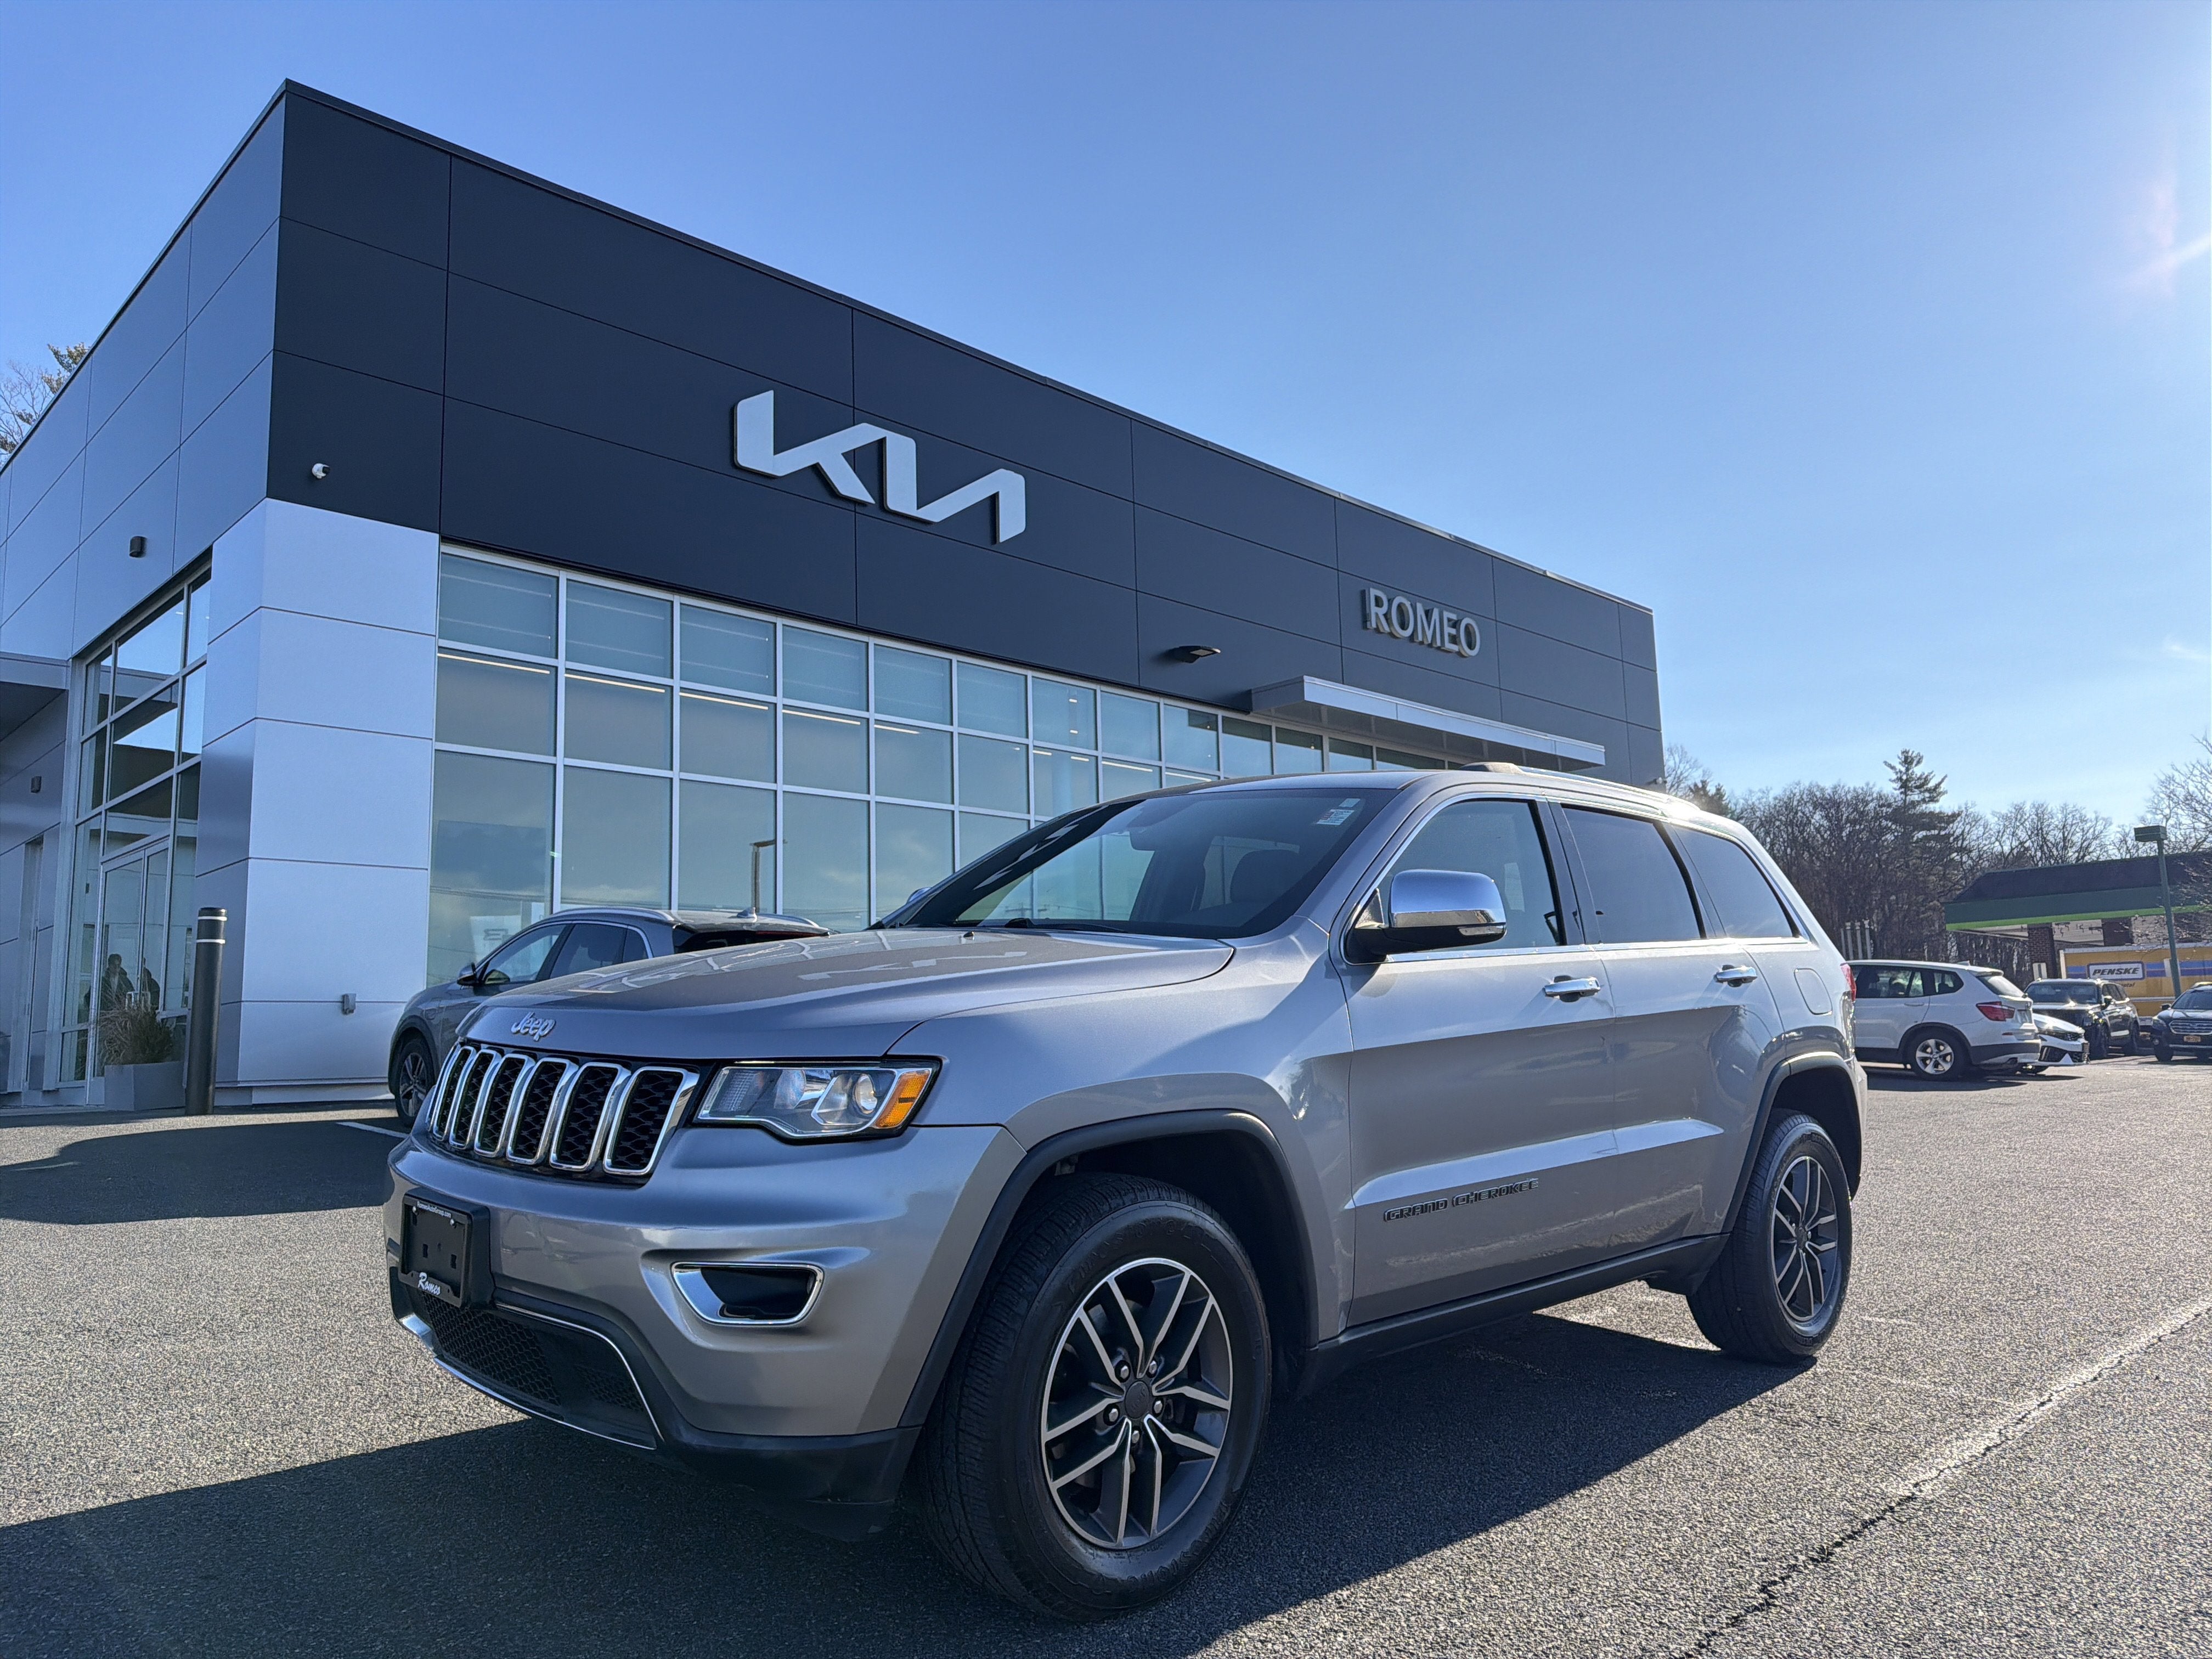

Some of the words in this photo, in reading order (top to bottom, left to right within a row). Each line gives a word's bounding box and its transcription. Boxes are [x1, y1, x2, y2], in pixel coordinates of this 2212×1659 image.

[1367, 588, 1481, 657] ROMEO
[2092, 967, 2140, 976] PENSKE
[511, 1012, 556, 1041] Jeep
[1384, 1198, 1448, 1222] GRAND
[1452, 1178, 1539, 1207] CHEROKEE
[417, 1272, 441, 1295] Romeo
